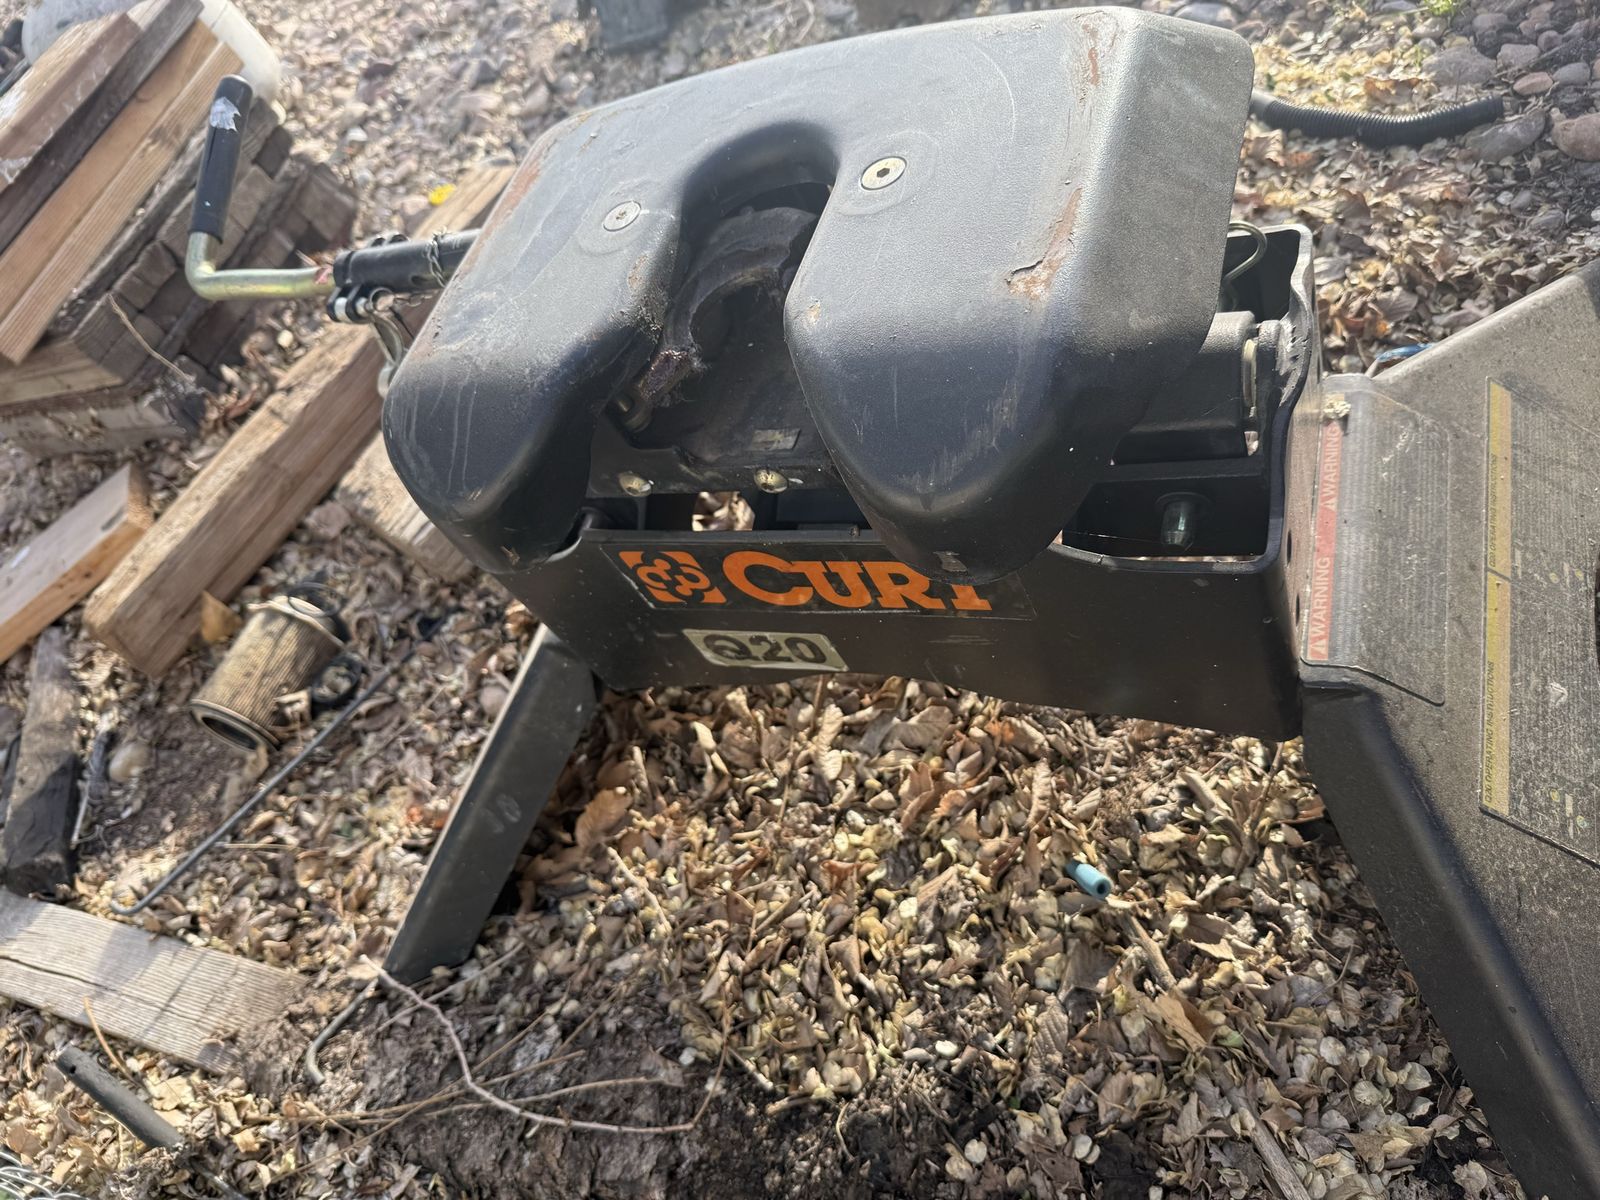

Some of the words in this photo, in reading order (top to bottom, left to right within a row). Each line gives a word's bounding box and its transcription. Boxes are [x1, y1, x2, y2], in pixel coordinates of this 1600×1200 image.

[1323, 427, 1340, 497] WARNING
[1490, 453, 1498, 506] INSTRUCTIONS
[1489, 507, 1497, 551] OPERATING
[1311, 557, 1330, 638] WARNING
[704, 634, 828, 664] Q20
[1486, 661, 1495, 727] INSTRUCTIONS
[1485, 728, 1494, 782] OPERATING
